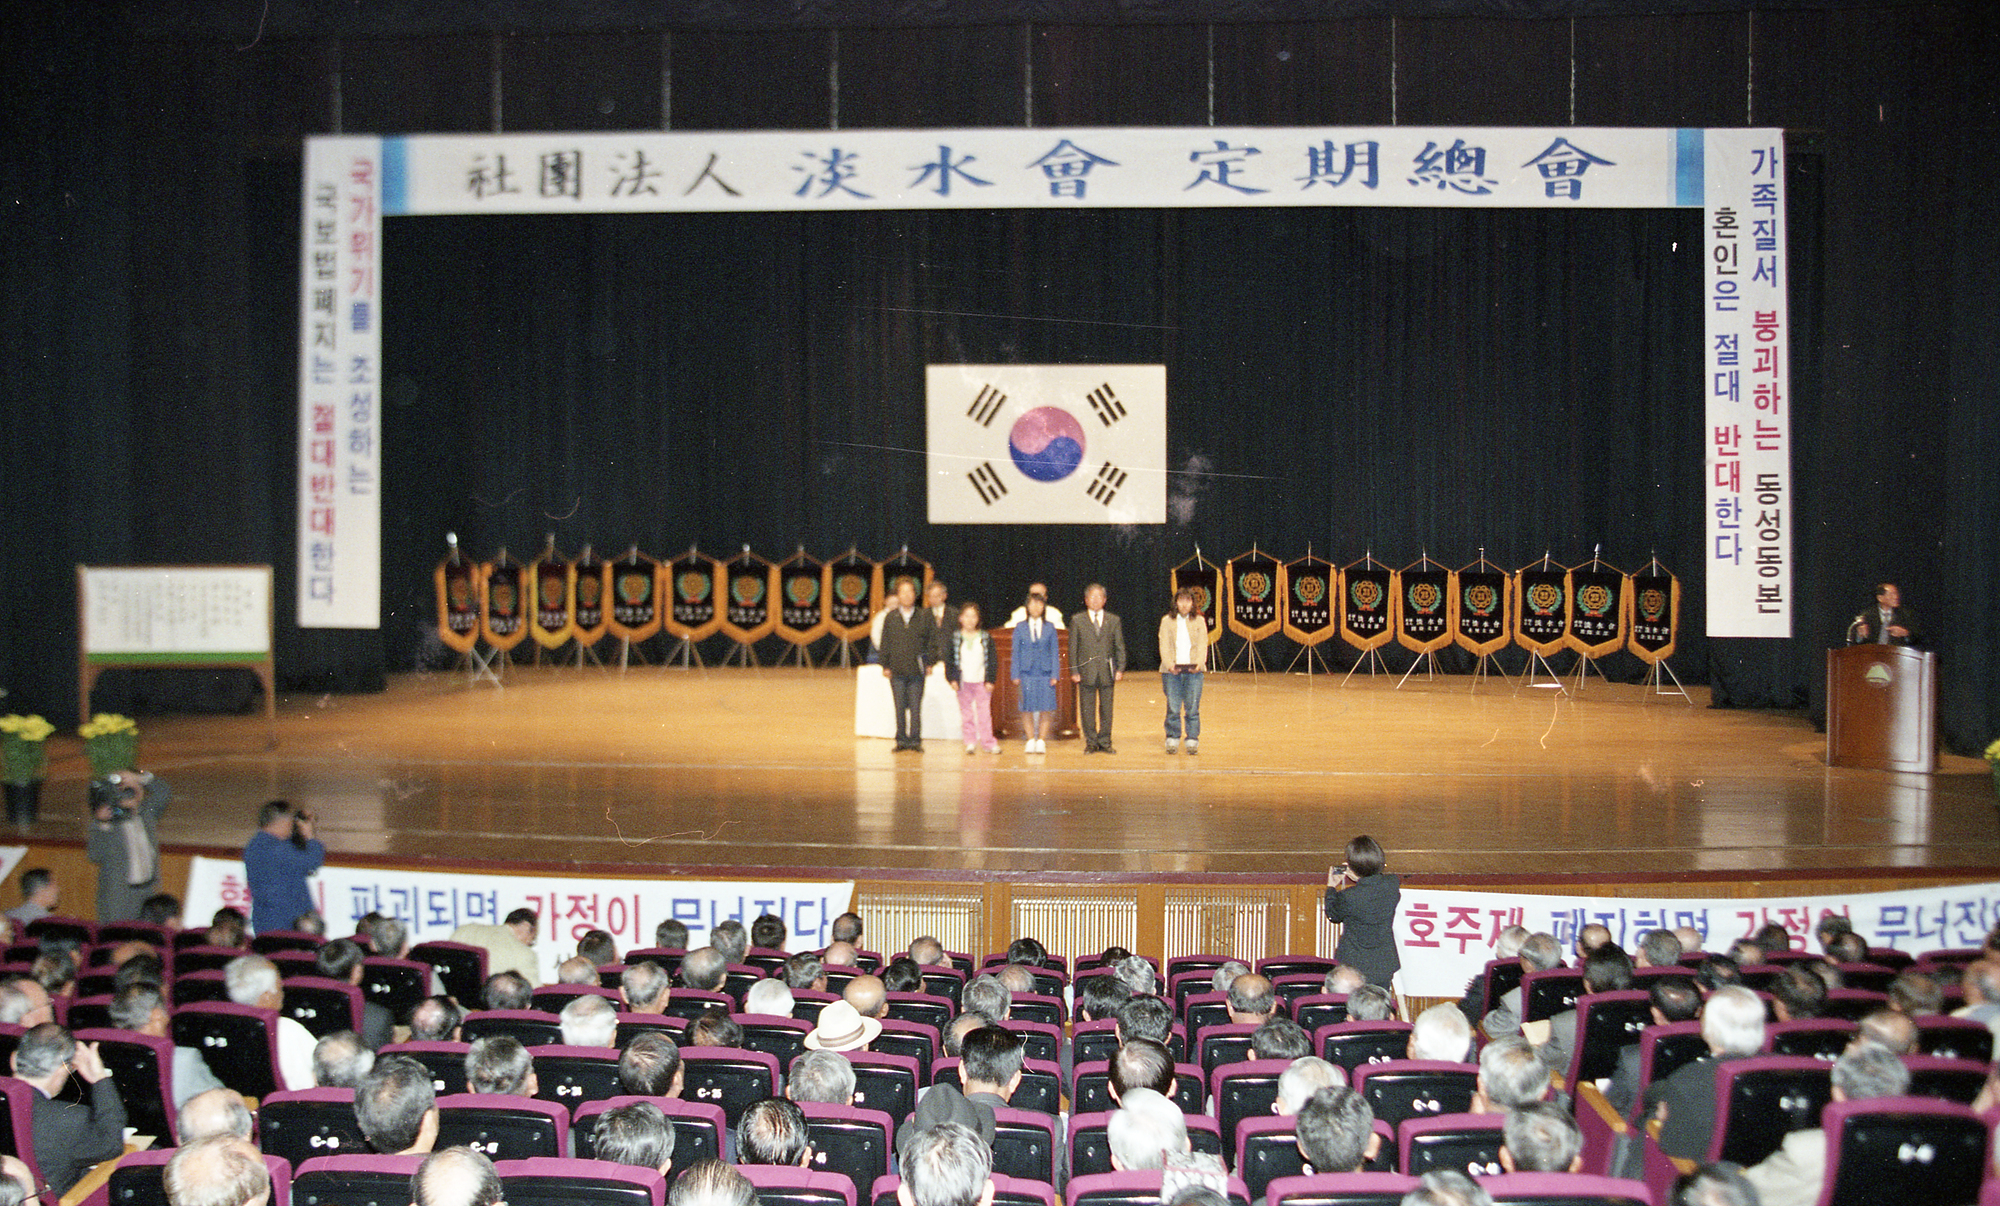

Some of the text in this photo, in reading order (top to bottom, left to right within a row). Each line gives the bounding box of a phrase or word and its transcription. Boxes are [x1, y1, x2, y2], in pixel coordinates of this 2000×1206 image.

[466, 137, 1618, 201] 社團法人 淡水會 定期總會
[1712, 206, 1743, 566] 혼인은 절대 반대한다
[1750, 146, 1783, 614] 가족질서 붕괴하는 동성동본
[525, 892, 640, 944] 가정이
[1403, 903, 1524, 954] 호주제
[1874, 897, 2000, 948] 무너진
